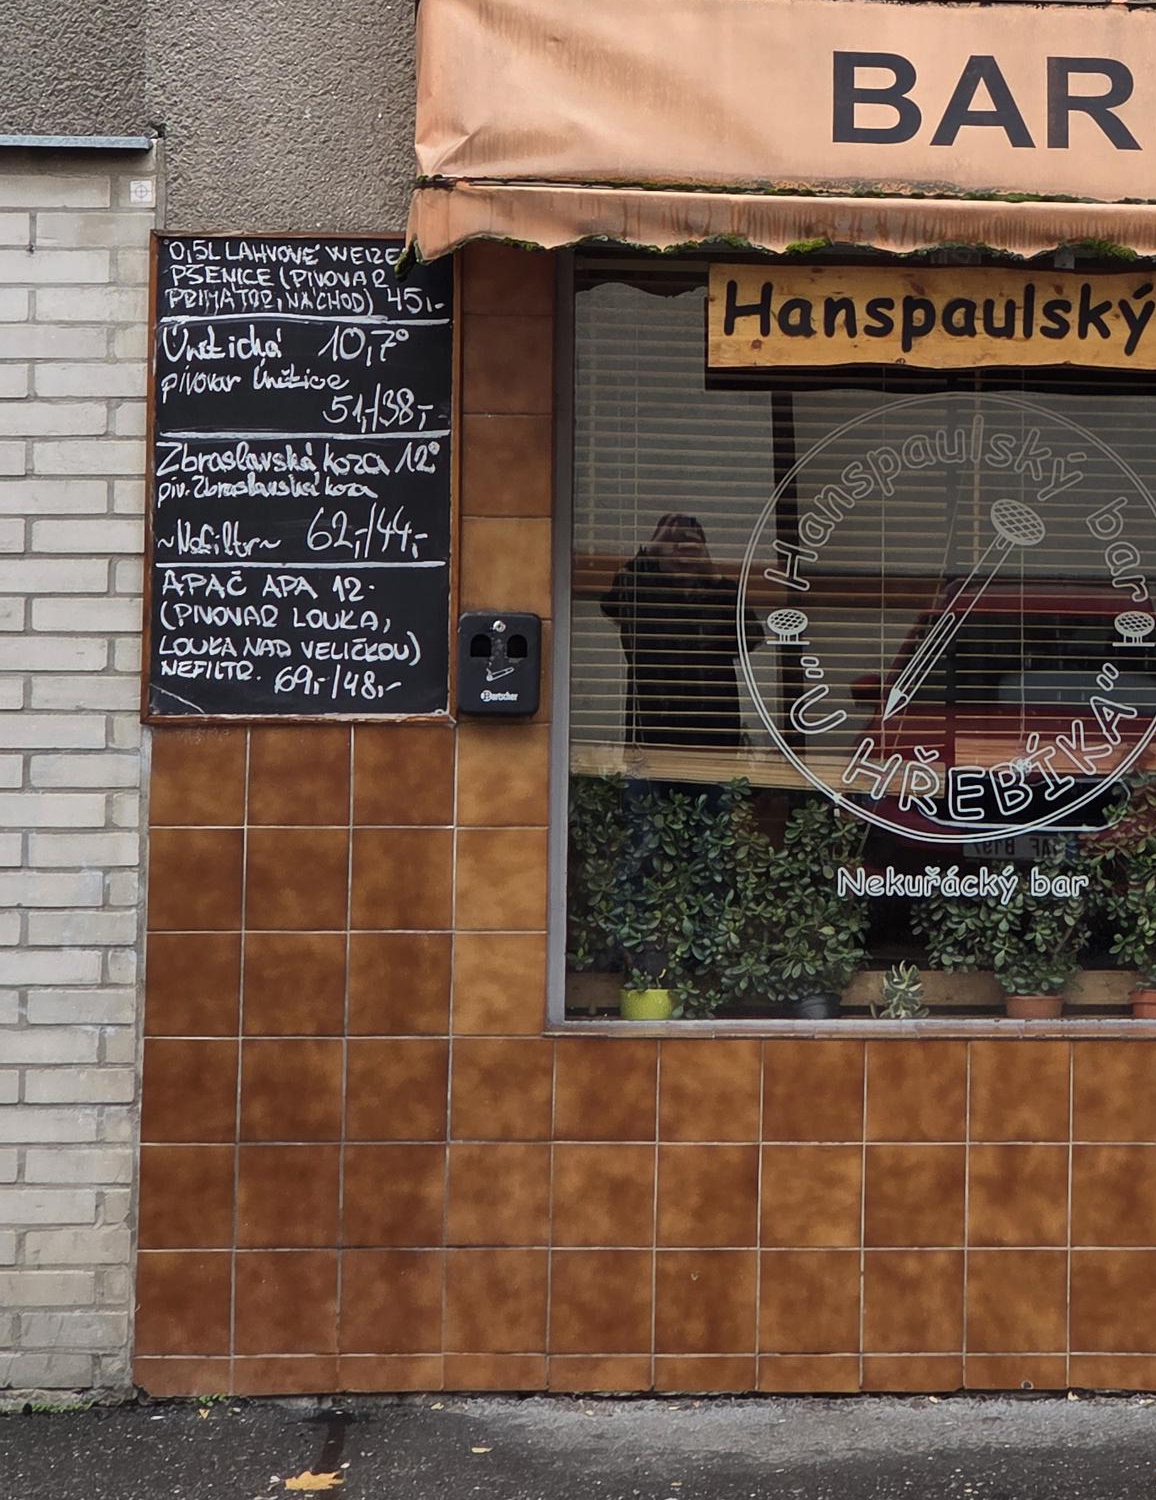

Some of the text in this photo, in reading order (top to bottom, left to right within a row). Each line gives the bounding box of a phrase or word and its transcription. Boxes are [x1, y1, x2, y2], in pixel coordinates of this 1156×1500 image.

[831, 50, 1144, 152] BAR
[724, 279, 1156, 356] Hanspaulský
[764, 415, 1148, 602] Hanspaulský bar
[262, 574, 318, 599] APA
[160, 600, 278, 631] (PIVOVAR
[159, 635, 237, 657] LOUKA
[243, 636, 292, 658] NAD
[837, 865, 1090, 905] Nekuřácký bar
